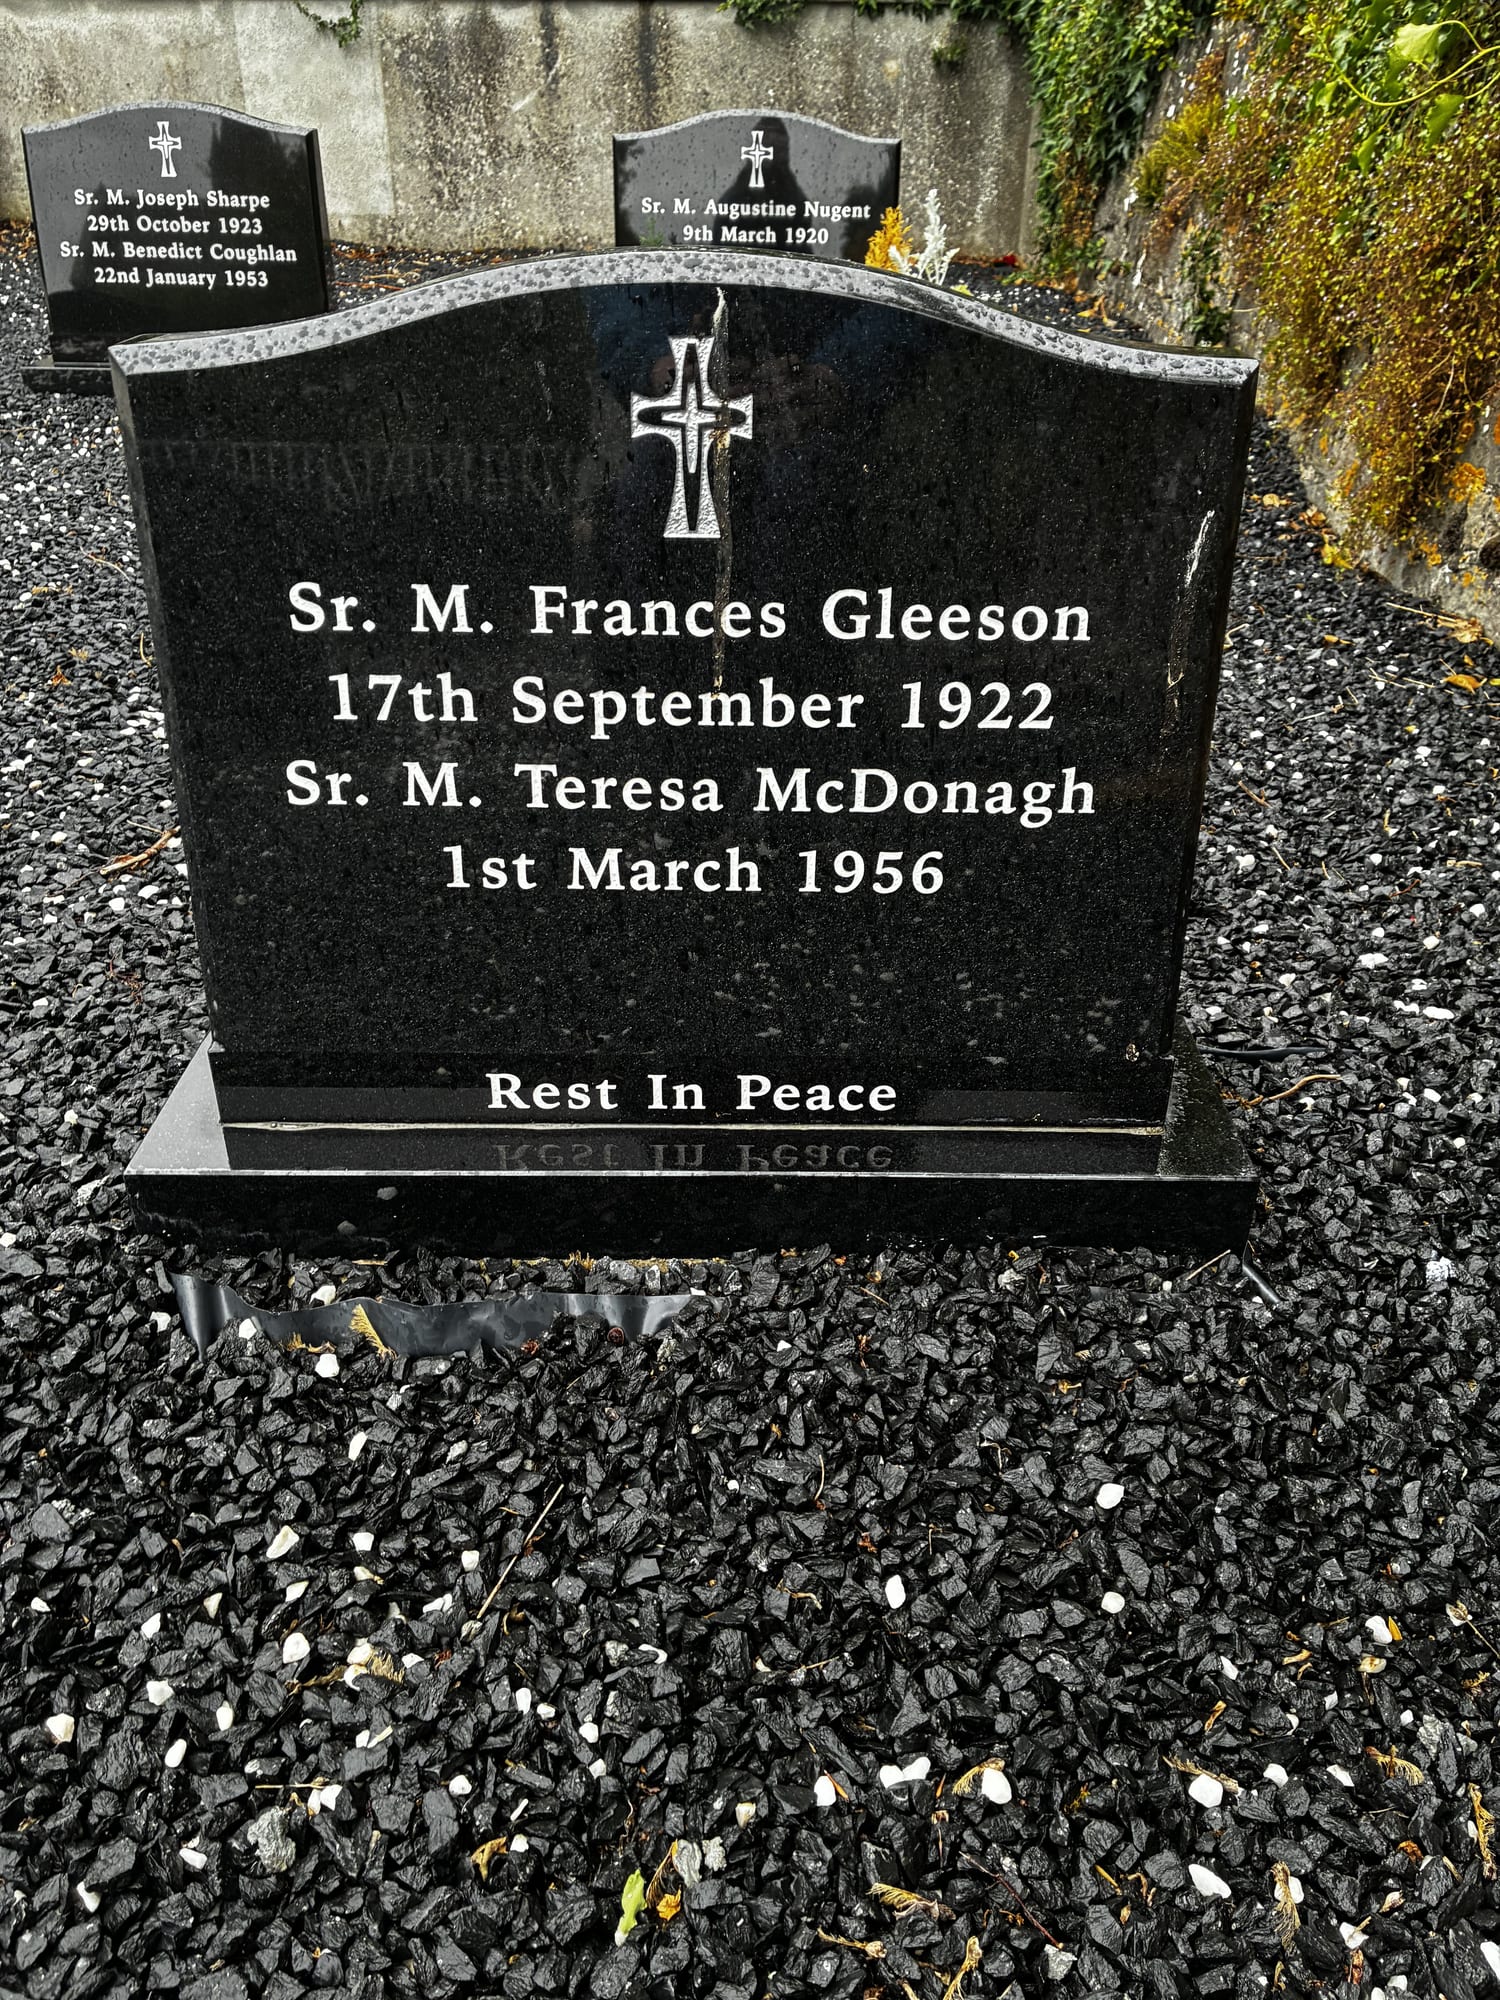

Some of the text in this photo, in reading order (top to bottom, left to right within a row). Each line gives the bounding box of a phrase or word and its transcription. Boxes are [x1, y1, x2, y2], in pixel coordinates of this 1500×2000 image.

[73, 188, 270, 213] Sr. M. Joseph Sharpe
[641, 196, 871, 223] Sr. M. Augustine Nugent
[86, 214, 263, 235] 29th October 1923
[682, 224, 829, 245] 9th March 1920
[60, 240, 297, 265] Sr. M. Benedict Coughlan
[94, 266, 268, 290] 22nd January 1953
[290, 582, 1090, 641] Sr. M. Frances Gleeson
[329, 672, 1053, 739] 17th September 1922
[287, 760, 1094, 828] Sr. M. Teresa McDonagh
[443, 845, 943, 894] 1st March 1956
[486, 1074, 896, 1111] Rest In Peace
